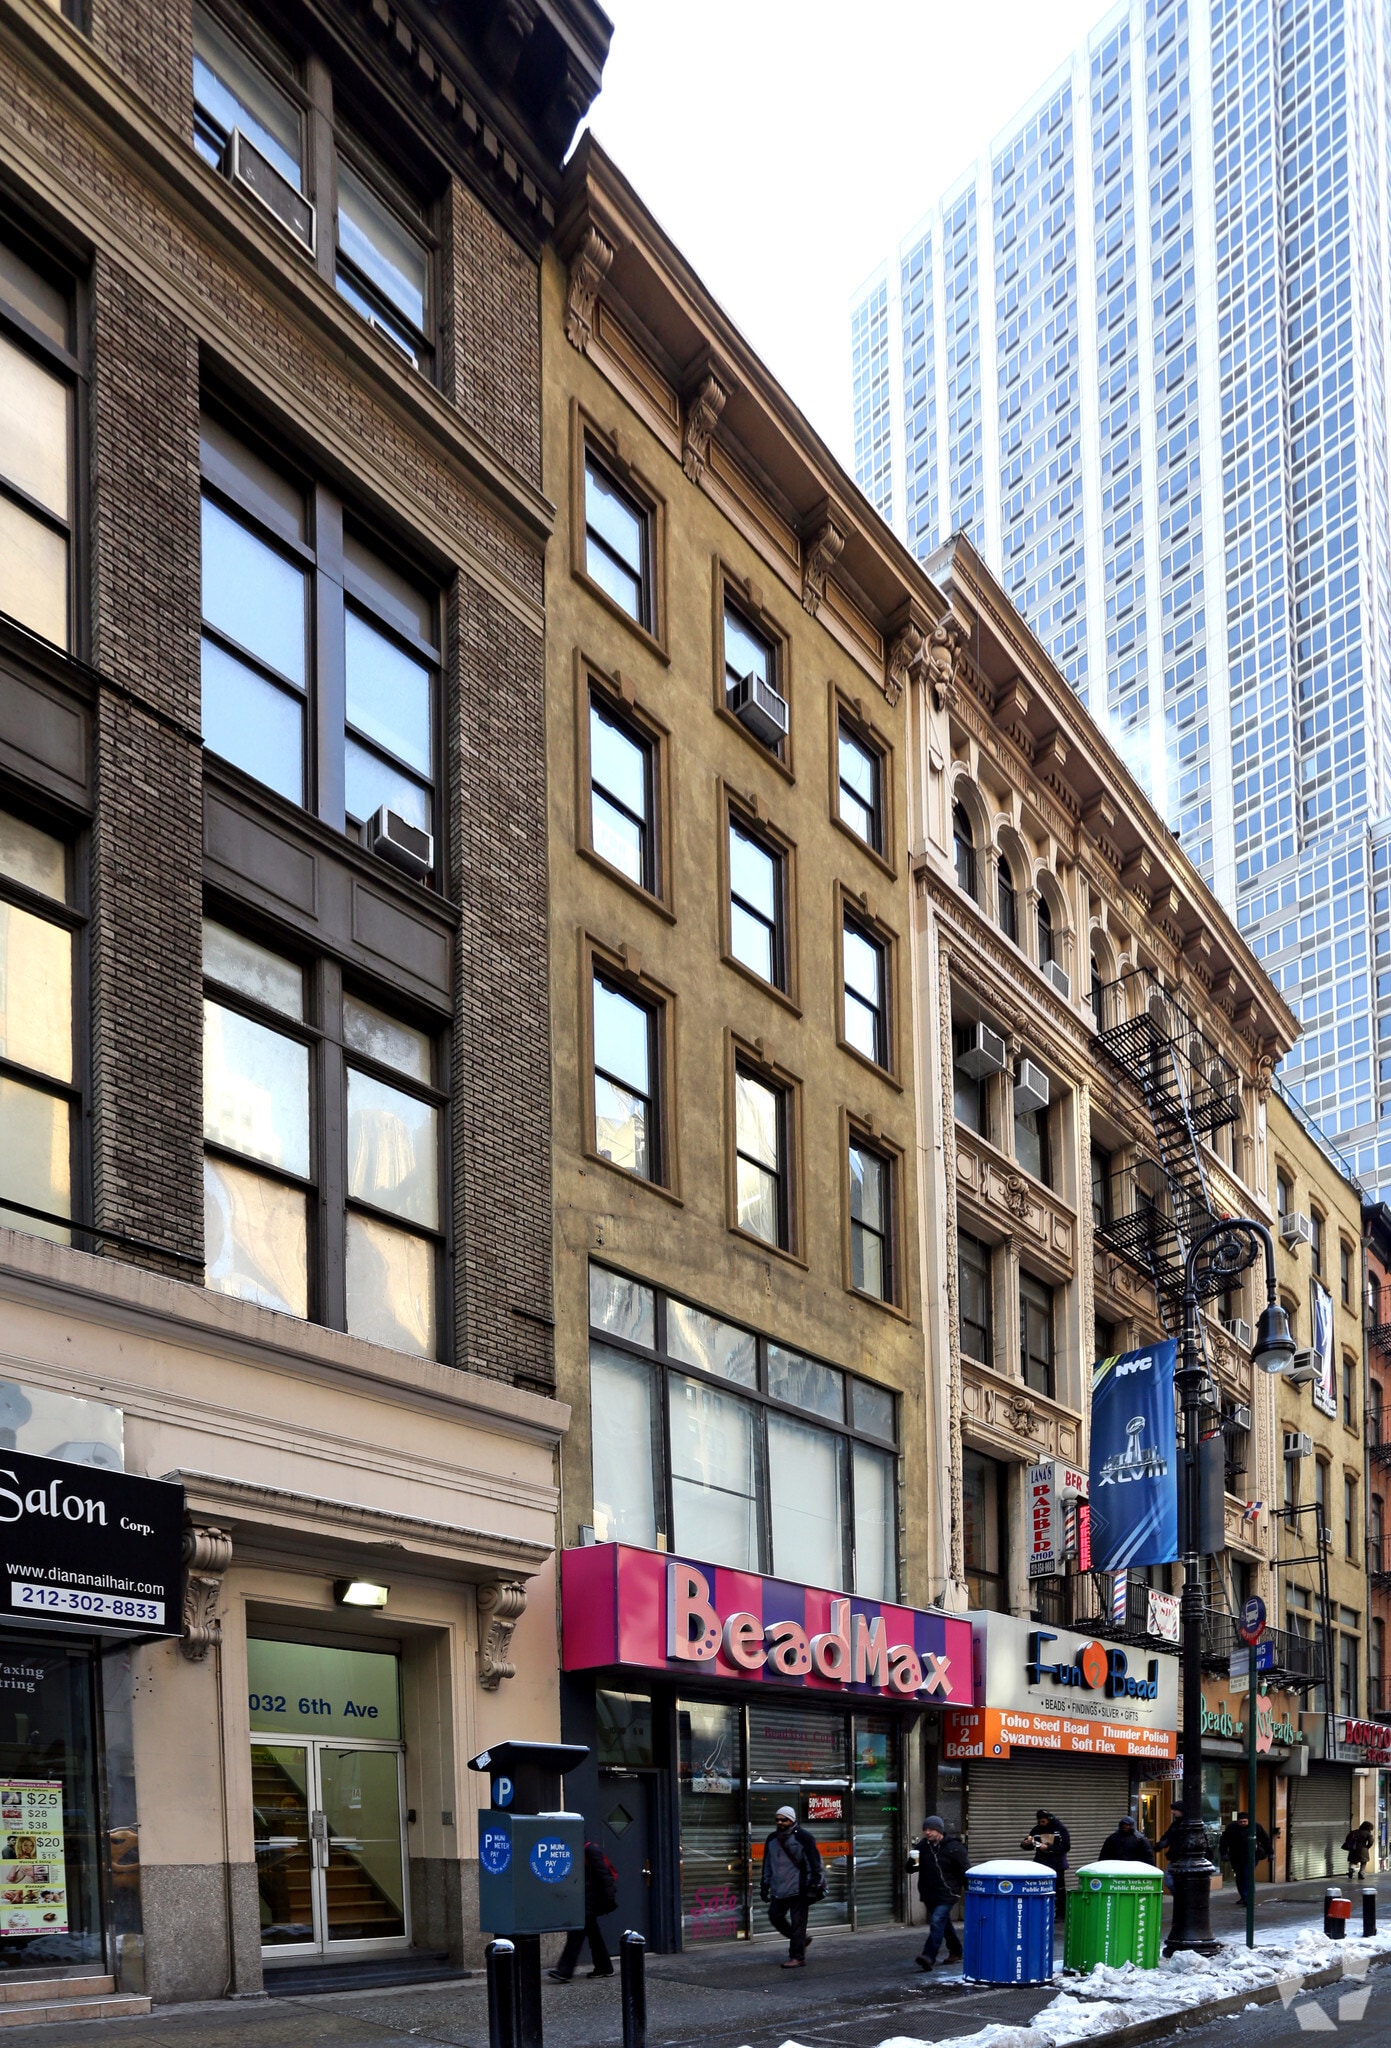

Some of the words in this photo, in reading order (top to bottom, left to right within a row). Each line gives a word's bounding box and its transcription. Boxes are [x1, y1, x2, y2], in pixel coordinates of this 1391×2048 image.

[1116, 1357, 1152, 1377] NYC
[1031, 1465, 1052, 1483] LANA'S
[1098, 1461, 1168, 1487] XLVIII
[120, 1516, 155, 1536] Corp.
[1032, 1484, 1051, 1553] BARBER
[1031, 1550, 1053, 1561] SHOP
[6, 1563, 165, 1596] www.diananailhair.com
[22, 1587, 157, 1620] 212-302-8833
[667, 1562, 953, 1696] BeadMax
[0, 1662, 44, 1680] axing
[1027, 1631, 1080, 1686] Fun
[1108, 1649, 1159, 1699] Bead
[0, 1678, 36, 1693] tring
[248, 1694, 286, 1712] 032
[298, 1698, 332, 1715] 6th
[343, 1701, 378, 1718] Ave
[1045, 1699, 1066, 1712] BEADS
[1072, 1703, 1097, 1716] FINDINGS
[1101, 1707, 1119, 1719] SILVER
[1124, 1711, 1139, 1721] GIFTS
[952, 1712, 979, 1727] Fun
[999, 1712, 1030, 1729] Toho
[1033, 1717, 1060, 1732] Seed
[1063, 1721, 1089, 1735] Bead
[1101, 1725, 1141, 1740] Thunder
[1143, 1731, 1169, 1743] Polish
[960, 1728, 970, 1742] 2
[1000, 1729, 1061, 1748] Swarovski
[1072, 1737, 1093, 1751] Soft
[1096, 1740, 1115, 1752] Flex
[1128, 1742, 1169, 1757] Beadalon
[1345, 1720, 1391, 1748] BONITO
[947, 1741, 983, 1756] Bead
[27, 1792, 58, 1805] $25
[498, 1777, 511, 1805] P
[28, 1810, 48, 1818] $28
[28, 1821, 48, 1829] $38
[36, 1837, 60, 1847] $20
[485, 1834, 492, 1849] P
[538, 1843, 547, 1858] P
